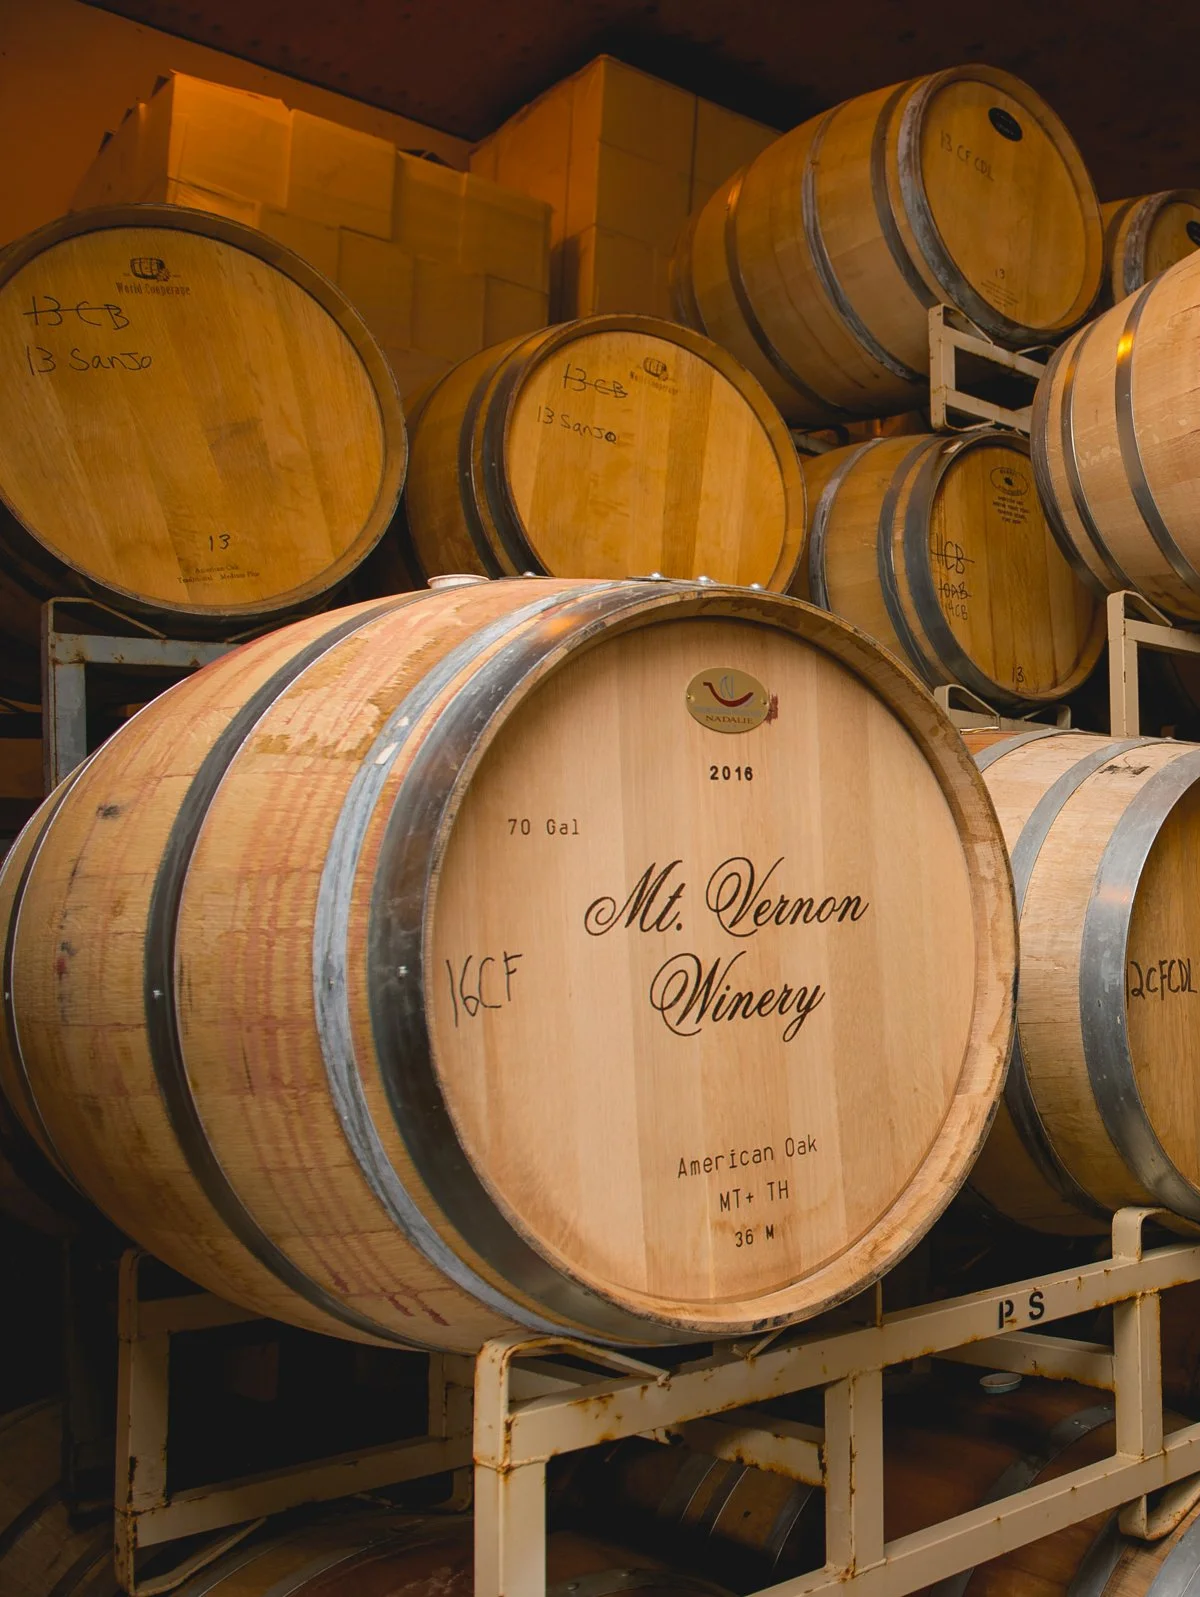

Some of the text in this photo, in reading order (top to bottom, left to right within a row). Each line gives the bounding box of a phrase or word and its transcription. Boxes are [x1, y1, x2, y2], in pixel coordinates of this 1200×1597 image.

[116, 282, 191, 296] World Cooperage
[27, 346, 56, 375] 13
[537, 406, 554, 424] 13
[209, 534, 230, 552] 13
[1012, 666, 1024, 683] 13
[705, 715, 753, 724] NADALIE
[710, 765, 753, 781] 2016
[507, 818, 580, 836] 70 Gal
[584, 856, 869, 937] Mt. Vernon
[446, 951, 523, 1028] 16CF
[650, 950, 826, 1042] Winery
[678, 1134, 817, 1178] American Oak
[719, 1180, 789, 1212] MT+ TH
[735, 1224, 774, 1248] 36 M
[999, 1291, 1045, 1329] P S
